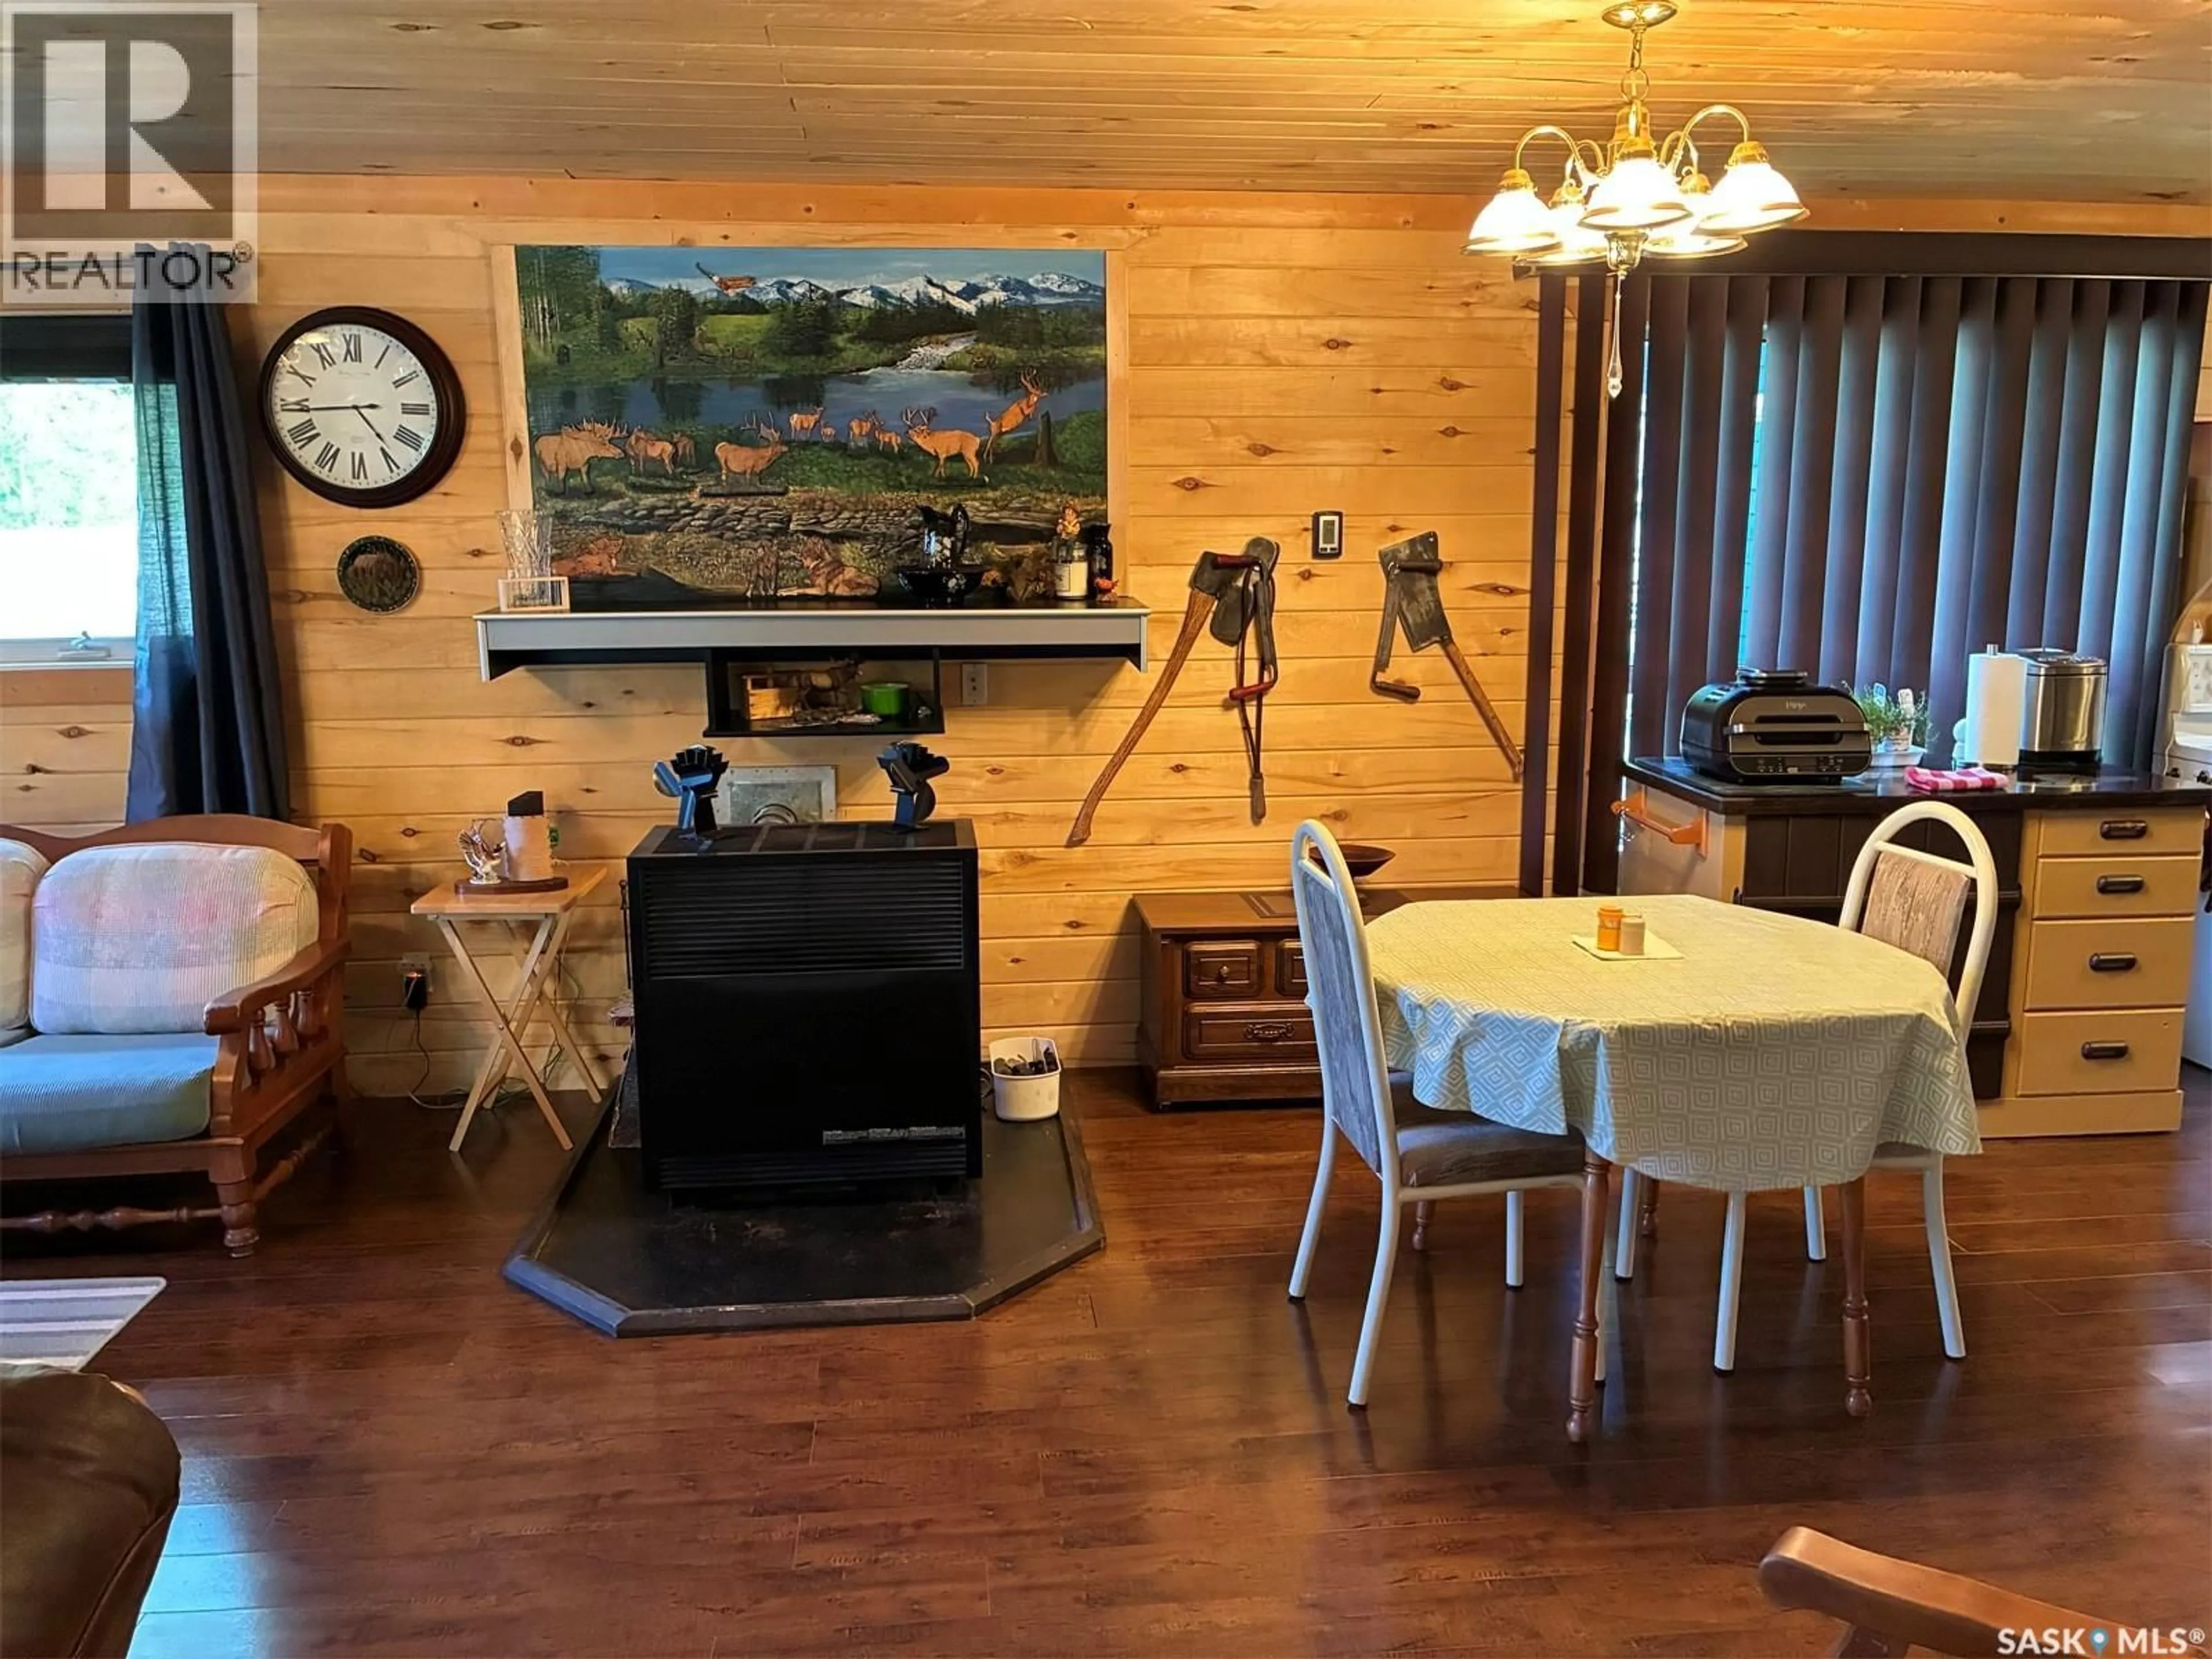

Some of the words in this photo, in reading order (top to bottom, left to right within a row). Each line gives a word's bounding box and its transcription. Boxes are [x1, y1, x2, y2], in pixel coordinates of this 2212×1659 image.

[342, 333, 362, 363] XII
[287, 364, 316, 388] X
[351, 451, 368, 480] VI
